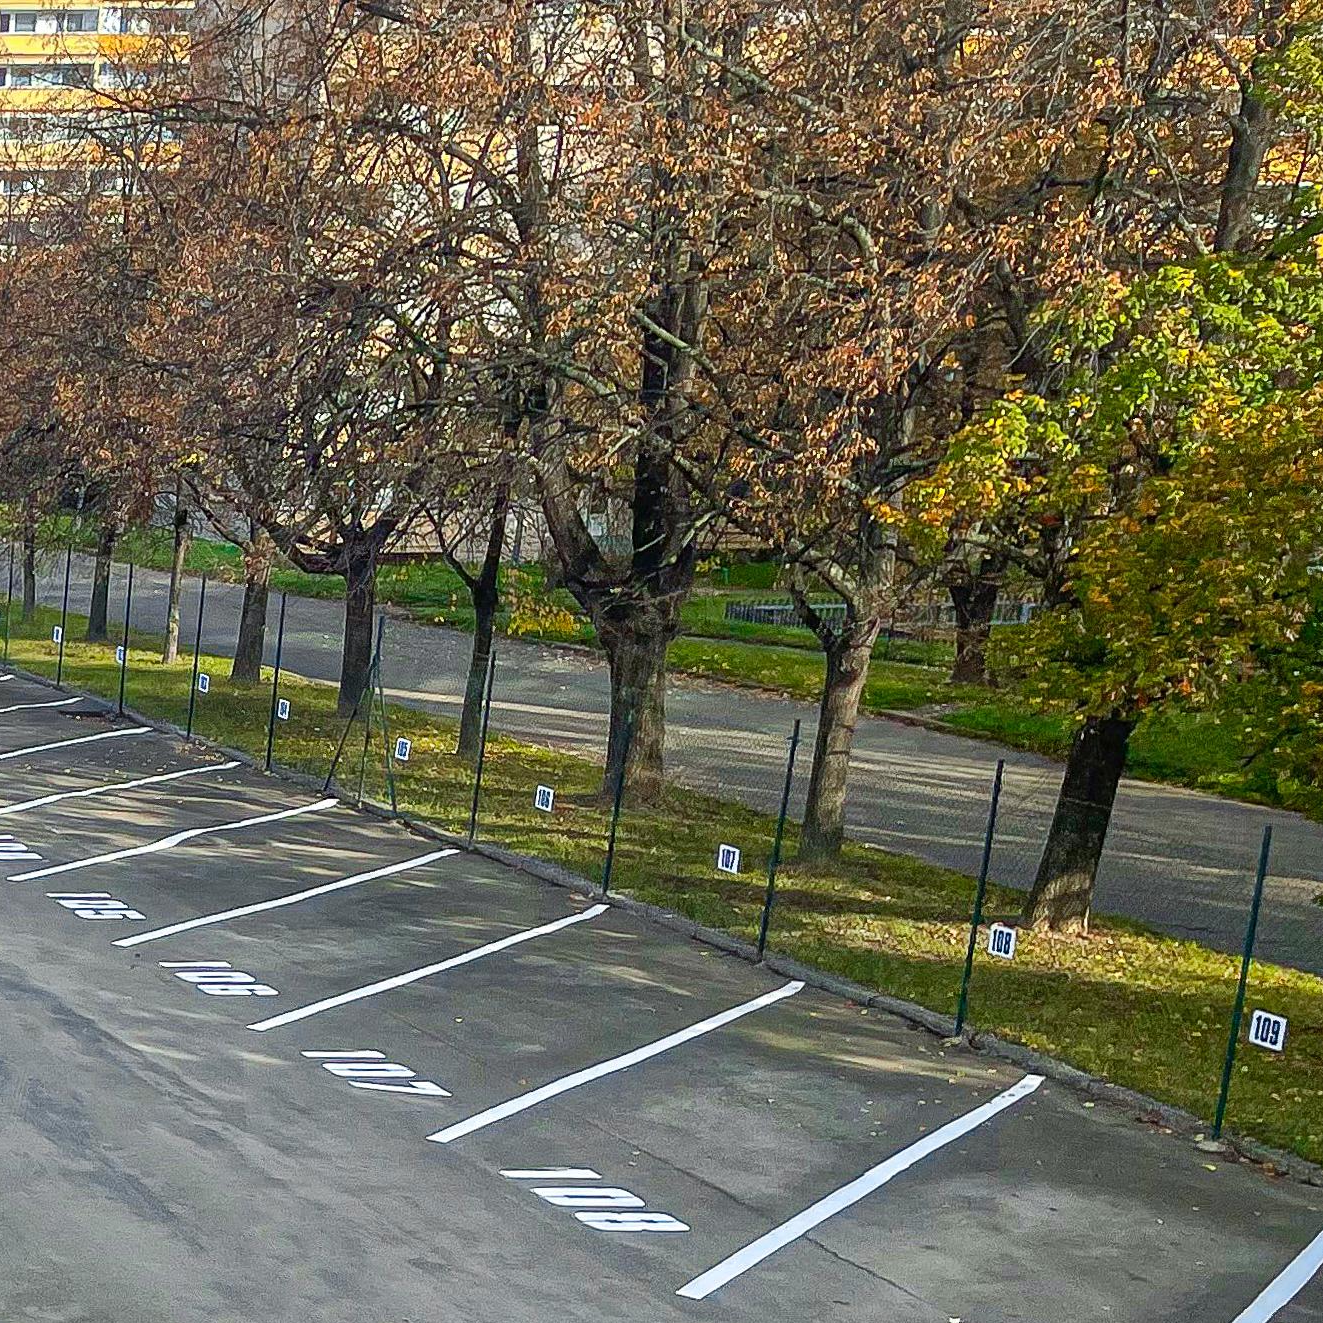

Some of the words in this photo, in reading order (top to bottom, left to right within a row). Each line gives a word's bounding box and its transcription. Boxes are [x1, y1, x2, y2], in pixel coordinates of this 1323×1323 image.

[538, 789, 550, 808] 106
[722, 849, 736, 870] 107
[46, 893, 145, 919] 105
[991, 929, 1014, 956] 108
[159, 962, 278, 995] 106
[1254, 1015, 1281, 1046] 109
[302, 1050, 451, 1096] 107
[500, 1169, 689, 1231] 108
